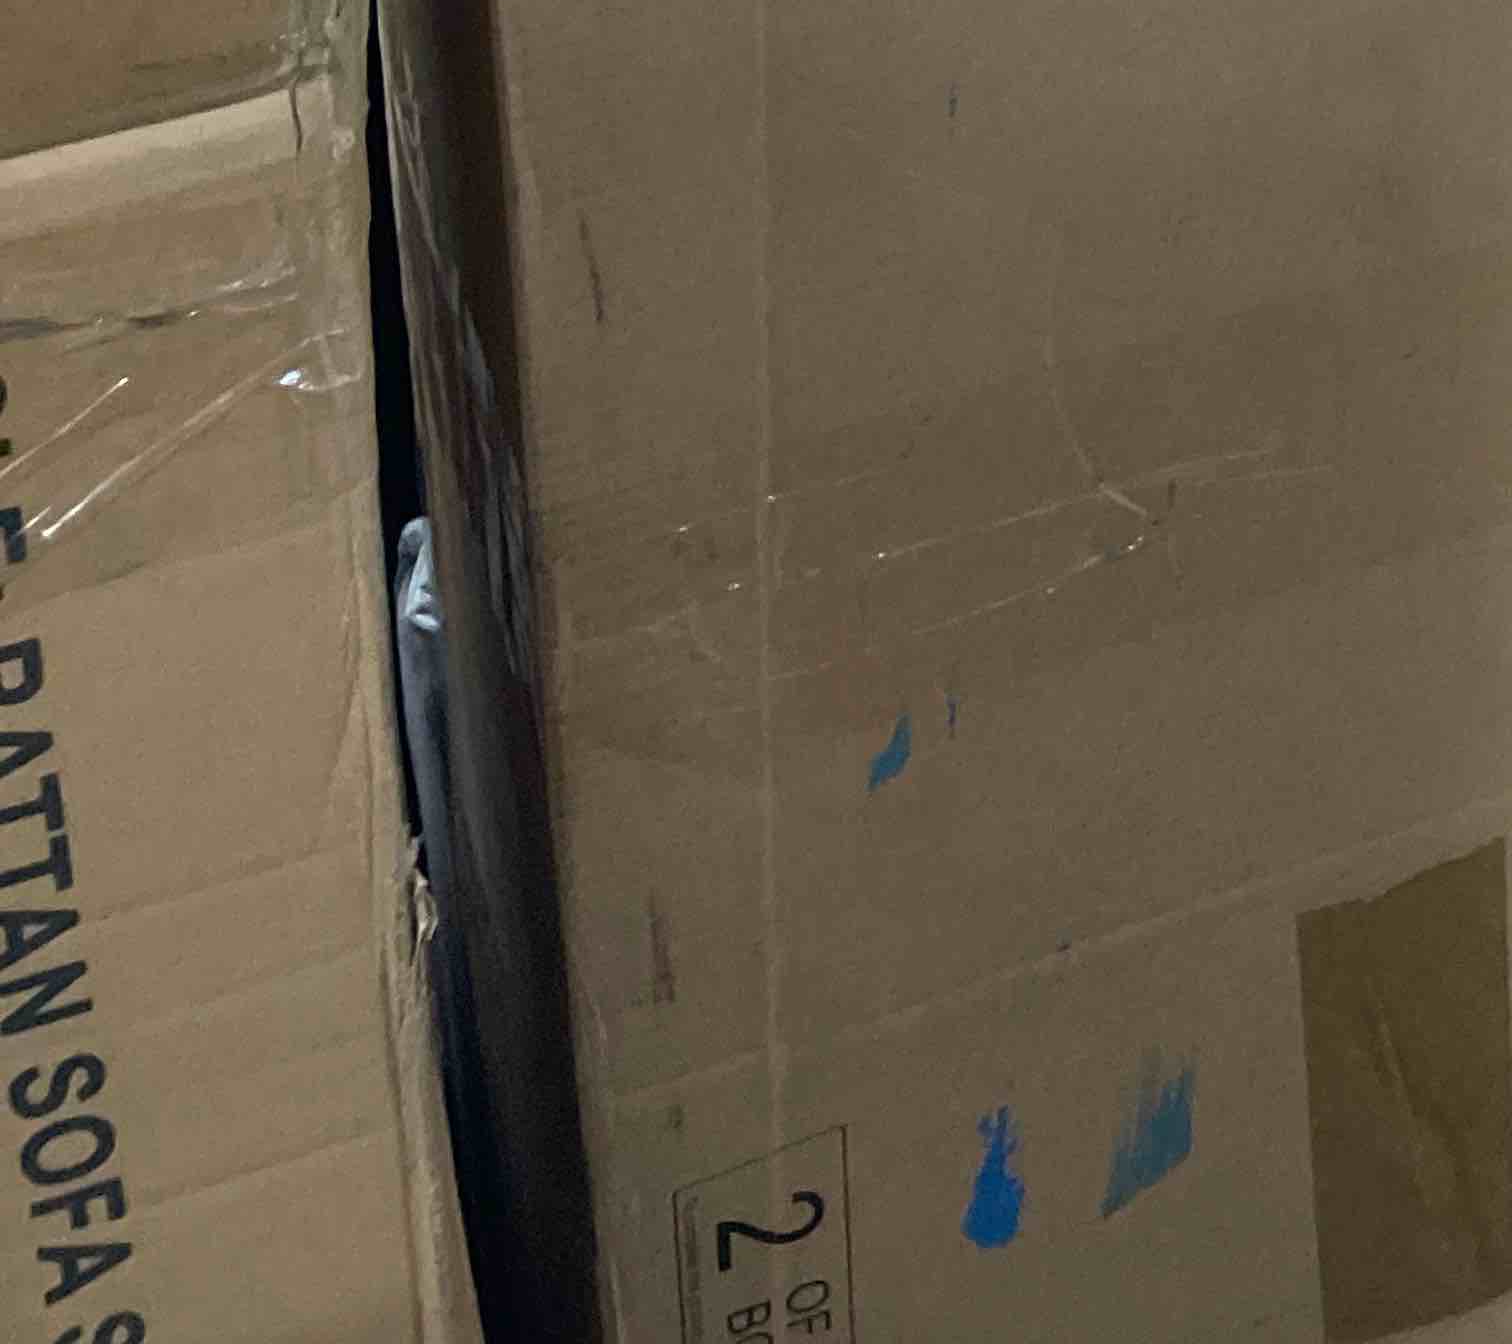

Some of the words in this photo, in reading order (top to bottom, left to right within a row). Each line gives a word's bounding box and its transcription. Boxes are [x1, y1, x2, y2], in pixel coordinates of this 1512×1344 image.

[8, 1051, 133, 1307] SOFA
[717, 1190, 825, 1272] 2
[786, 1280, 831, 1334] OF
